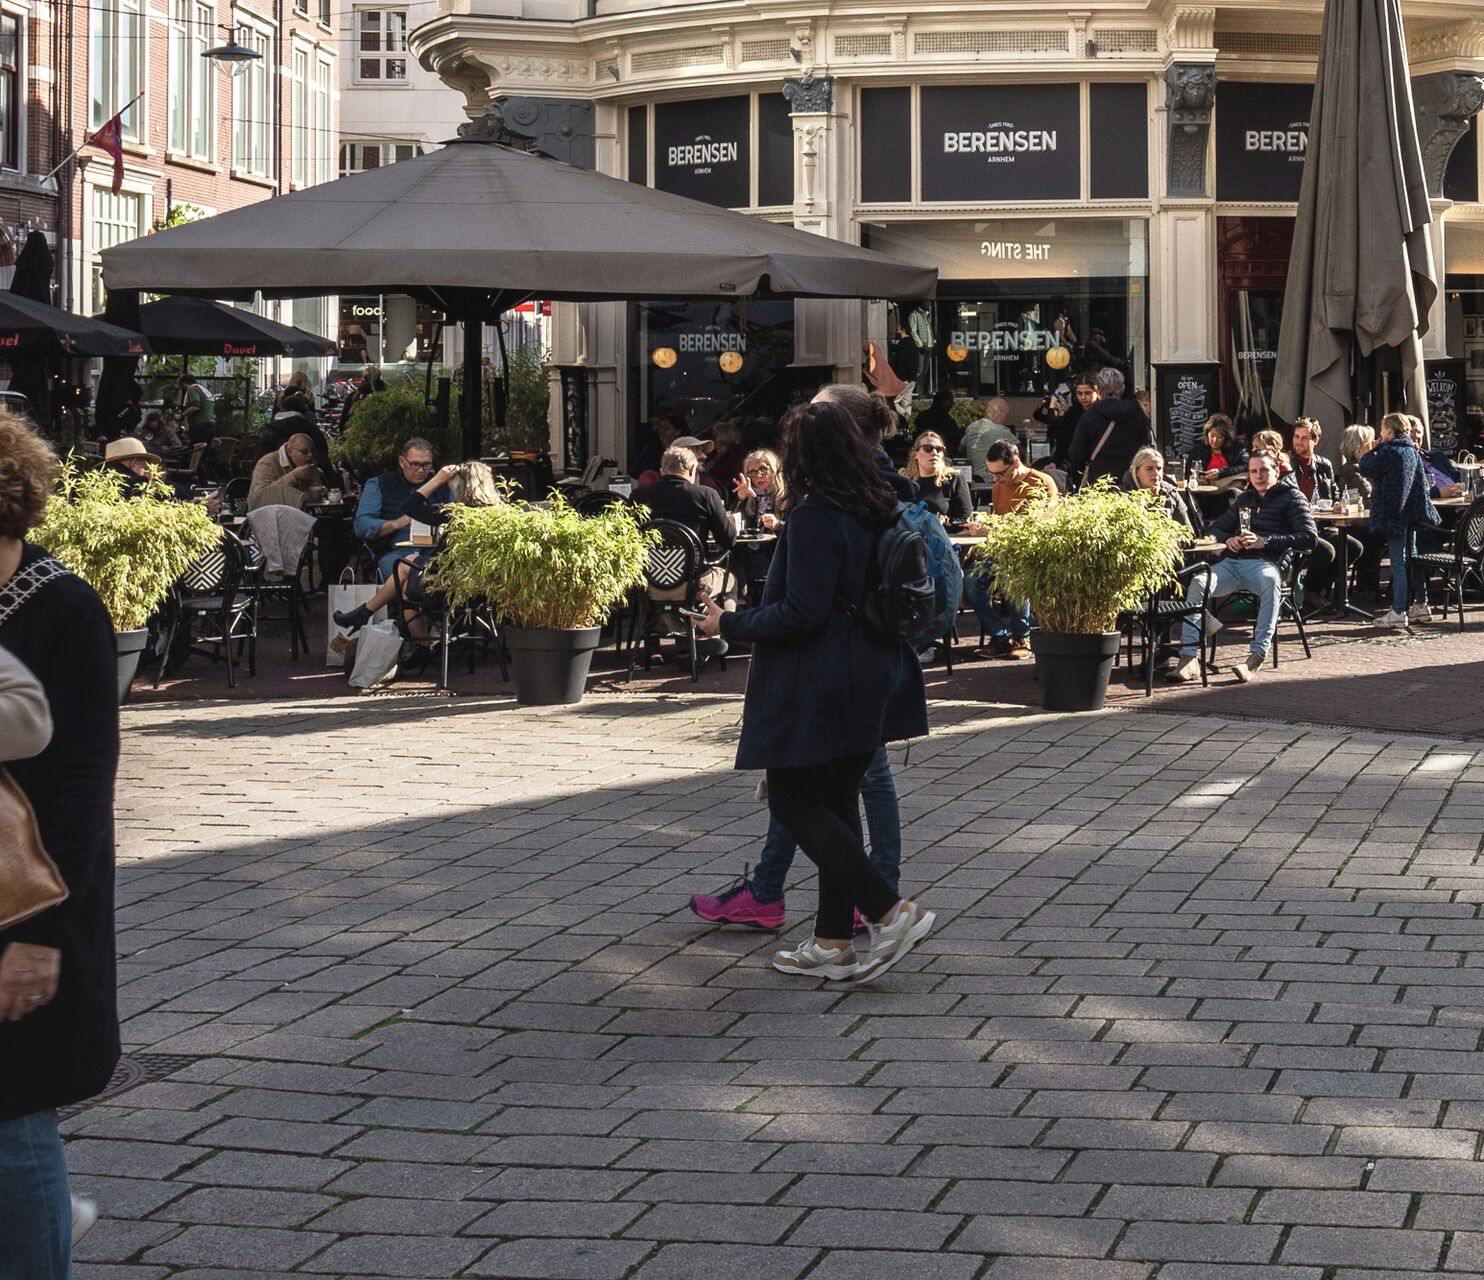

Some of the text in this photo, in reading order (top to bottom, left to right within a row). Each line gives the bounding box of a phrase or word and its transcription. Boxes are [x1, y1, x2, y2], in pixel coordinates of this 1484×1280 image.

[944, 130, 1057, 153] BERENSEN
[1245, 130, 1308, 152] BEREN
[668, 141, 737, 166] BERENSEN
[223, 342, 257, 355] Duvel
[679, 333, 747, 352] BERENSEN
[951, 329, 1060, 351] BERENSEN
[1238, 350, 1277, 360] BERENSEN
[1177, 381, 1199, 390] OPEN
